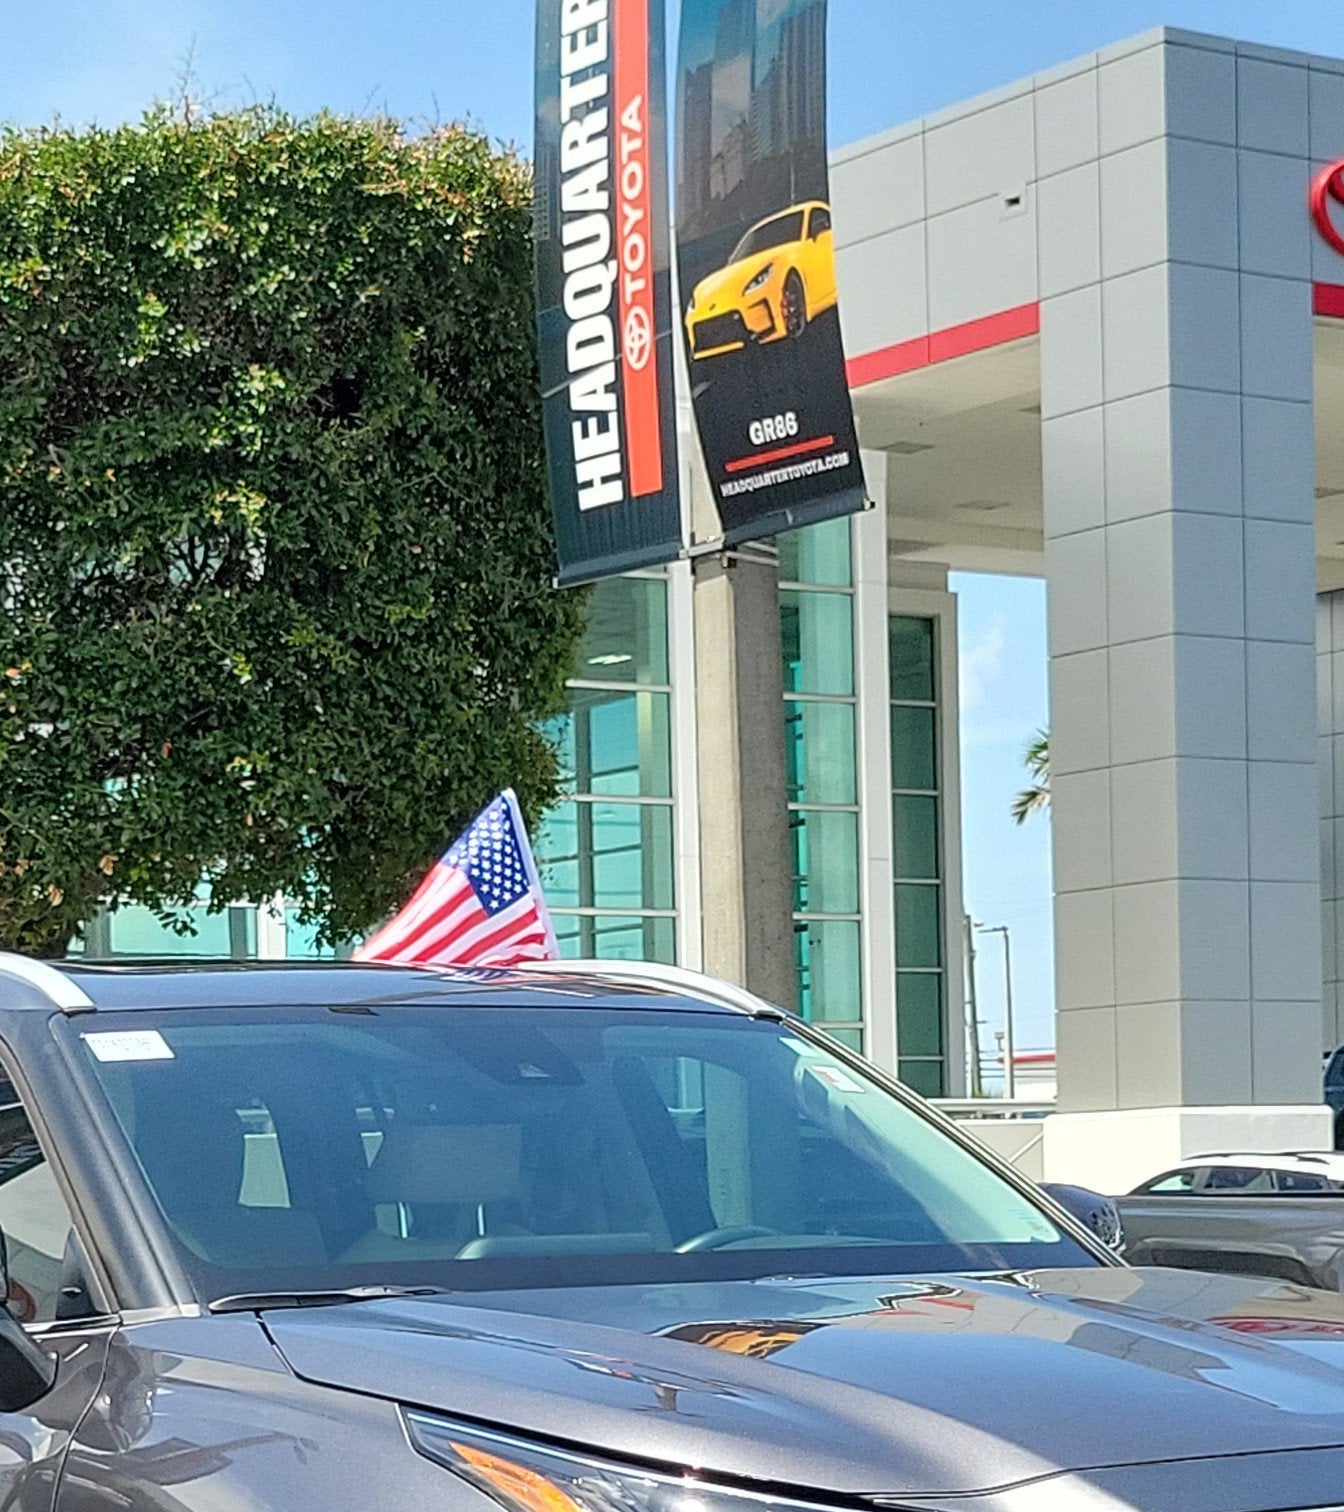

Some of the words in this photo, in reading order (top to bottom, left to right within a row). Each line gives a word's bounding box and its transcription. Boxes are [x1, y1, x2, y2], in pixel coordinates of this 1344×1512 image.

[560, 0, 624, 511] HEADQUARTER
[622, 94, 648, 304] TOYOTA
[720, 451, 850, 497] HEADQUARTERTOYOTA.COM
[749, 411, 798, 445] GR86
